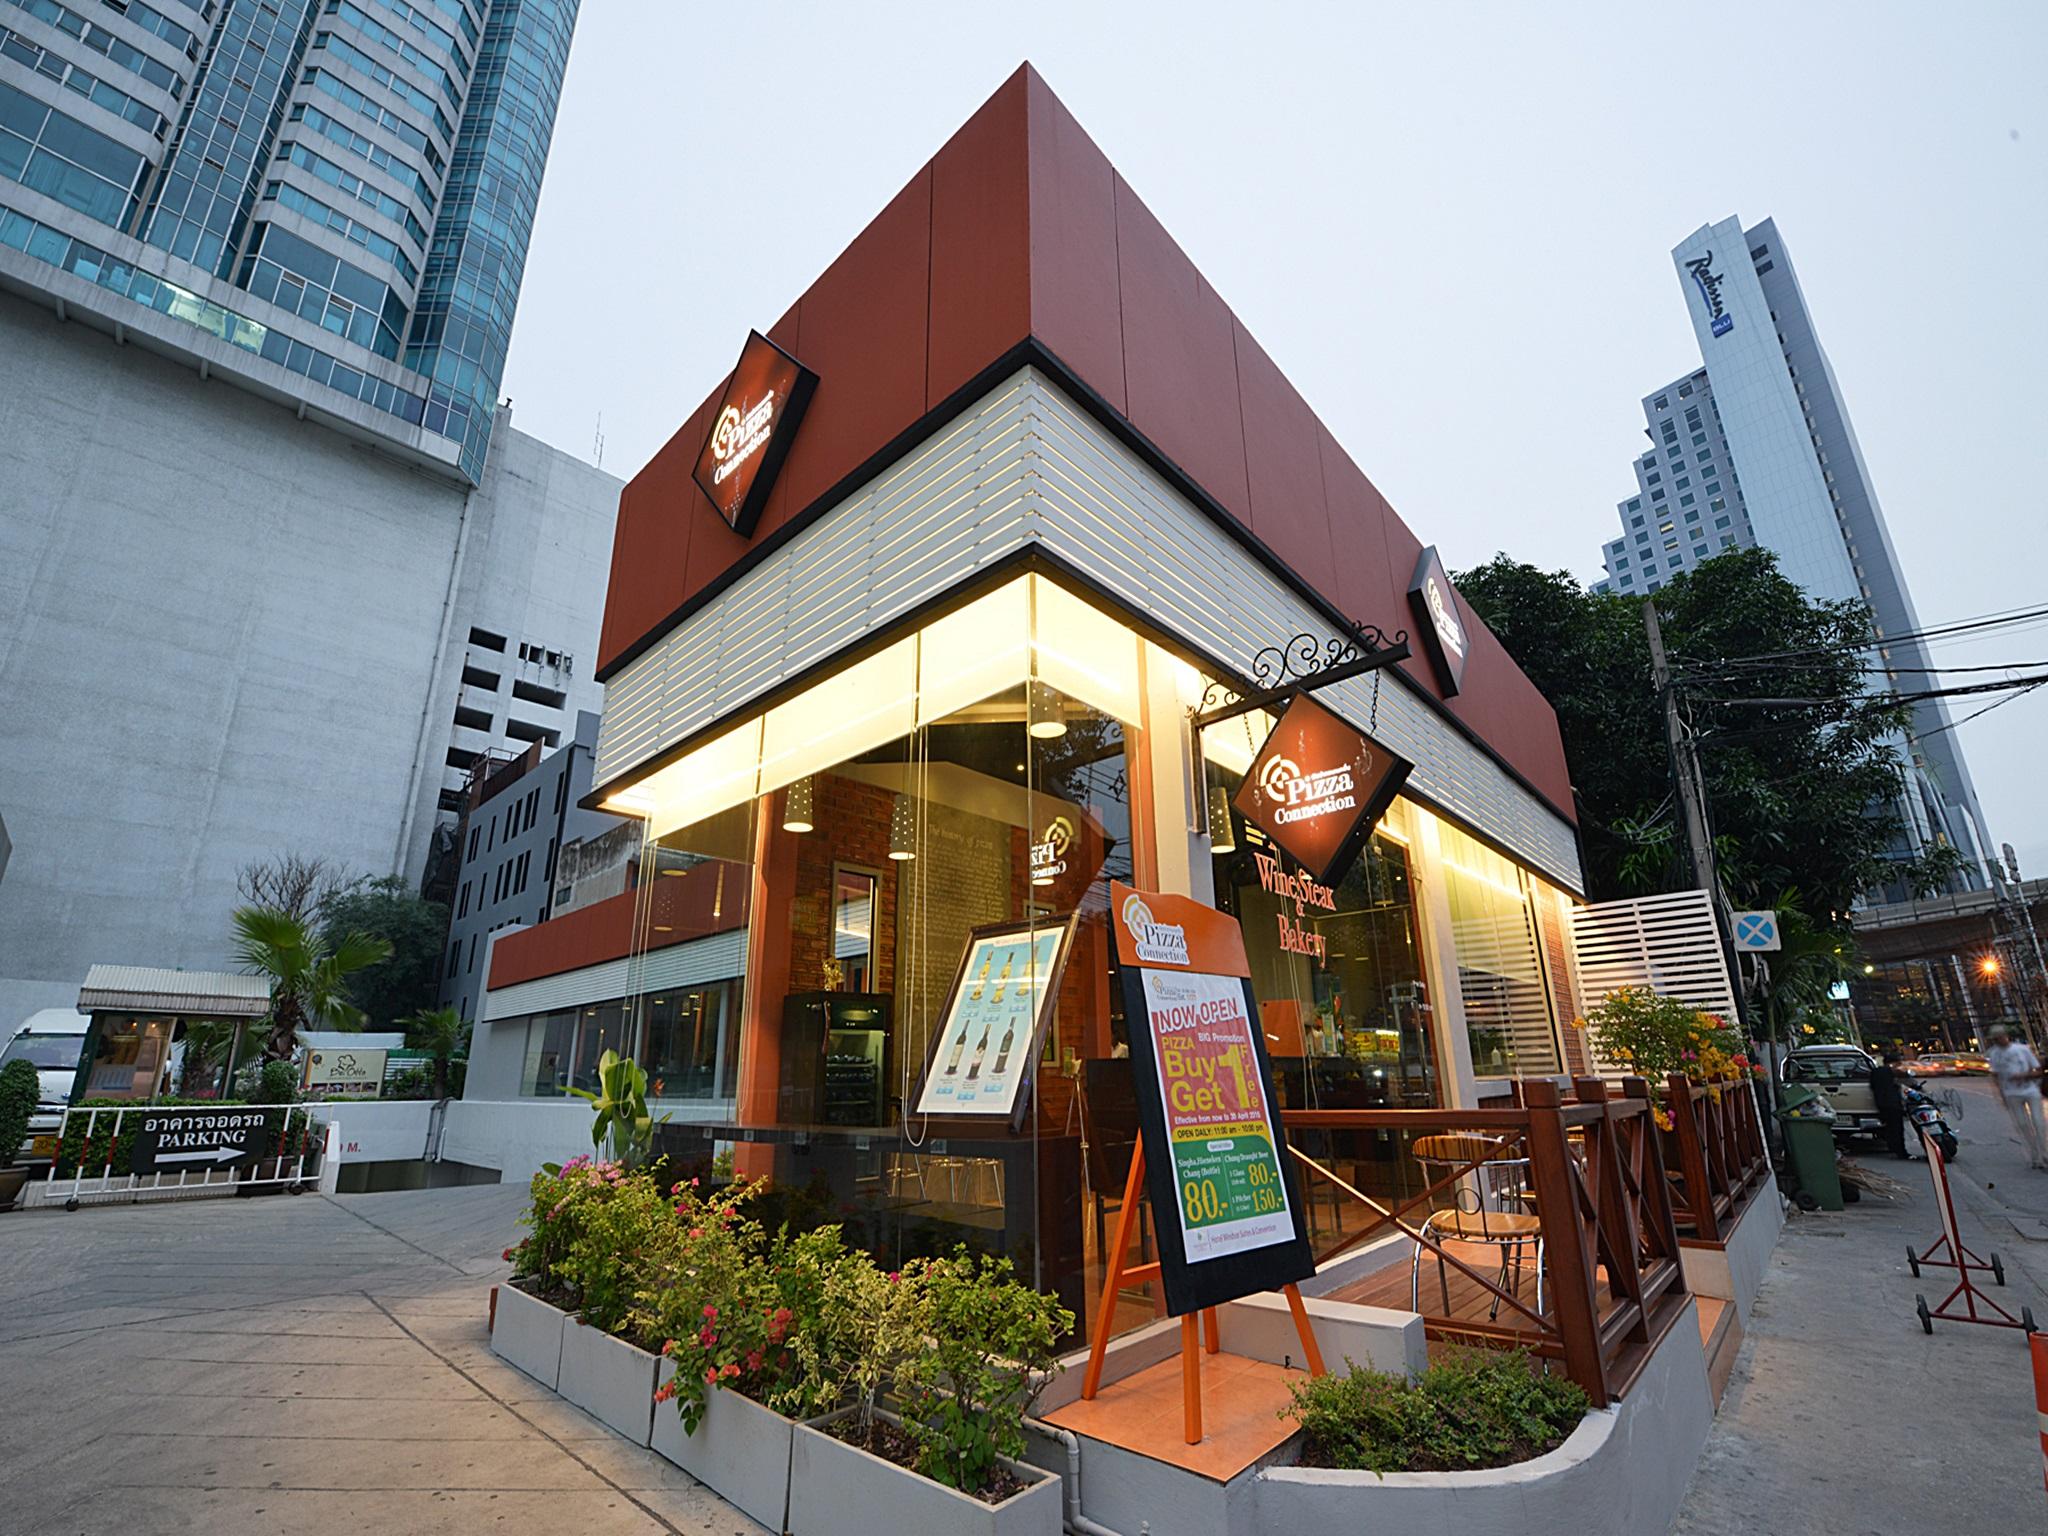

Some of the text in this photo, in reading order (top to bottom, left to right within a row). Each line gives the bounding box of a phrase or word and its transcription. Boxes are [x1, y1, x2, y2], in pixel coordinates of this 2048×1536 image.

[1685, 249, 1724, 320] Radisson
[726, 400, 774, 459] Pizza
[1285, 773, 1354, 806] Pizza
[1274, 795, 1356, 825] Connection
[1144, 924, 1185, 950] Pizza
[1277, 914, 1326, 968] Bakery
[1137, 945, 1188, 962] Connection
[1159, 996, 1239, 1032] NOW OPEN
[1162, 1037, 1196, 1050] PIZZA
[1198, 1032, 1245, 1043] BIG Promotion
[1164, 1044, 1250, 1109] Buy 1
[1170, 1081, 1225, 1112] Get
[145, 1113, 265, 1132] อาคารจอดรถ
[1177, 1129, 1194, 1138] OPEN
[157, 1129, 247, 1148] PARKING
[1183, 1168, 1201, 1178] Chang
[1248, 1162, 1277, 1187] 80.-
[1184, 1179, 1228, 1222] 80.-
[1252, 1188, 1283, 1213] 150.-
